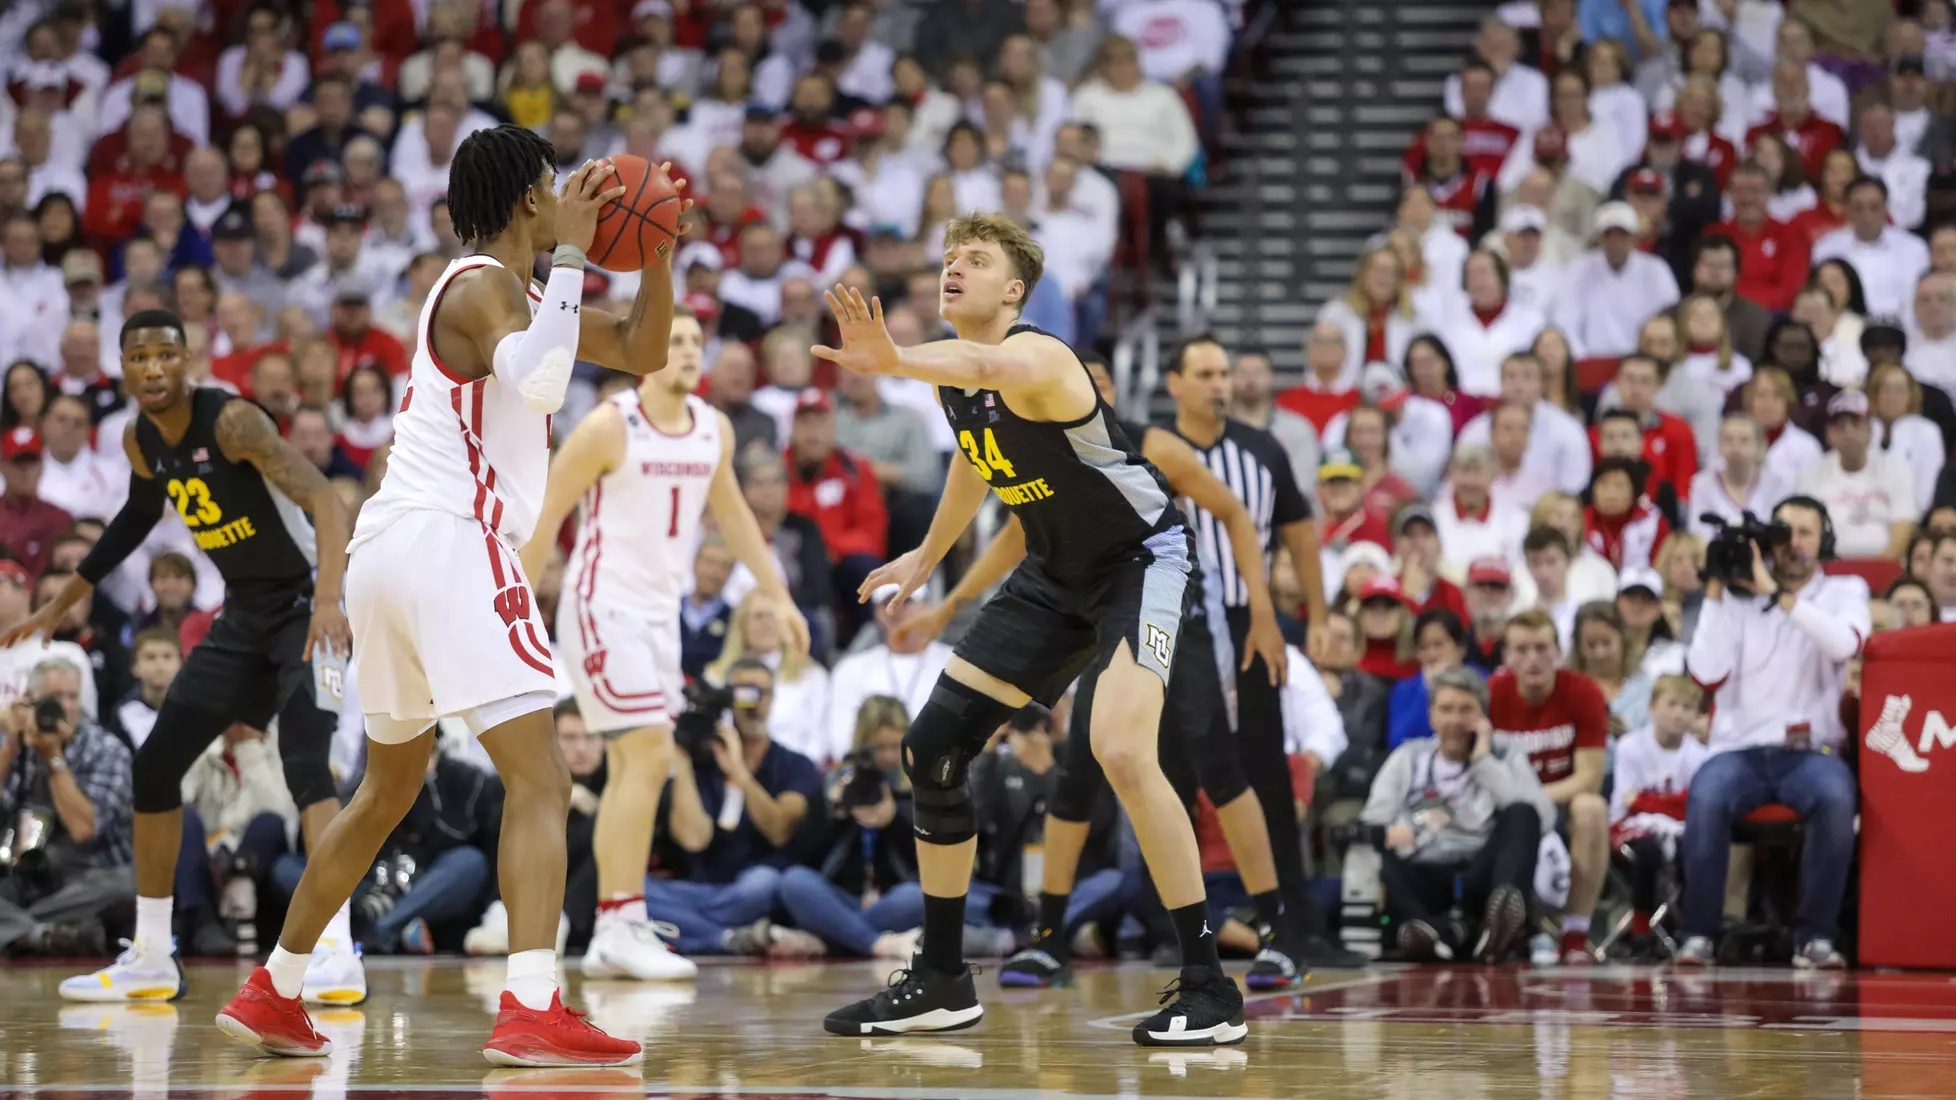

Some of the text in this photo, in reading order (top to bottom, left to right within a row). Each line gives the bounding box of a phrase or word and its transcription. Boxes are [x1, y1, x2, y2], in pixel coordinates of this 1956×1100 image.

[960, 427, 1016, 481] 34
[167, 477, 222, 526] 23
[669, 487, 679, 537] 1
[493, 585, 530, 628] W
